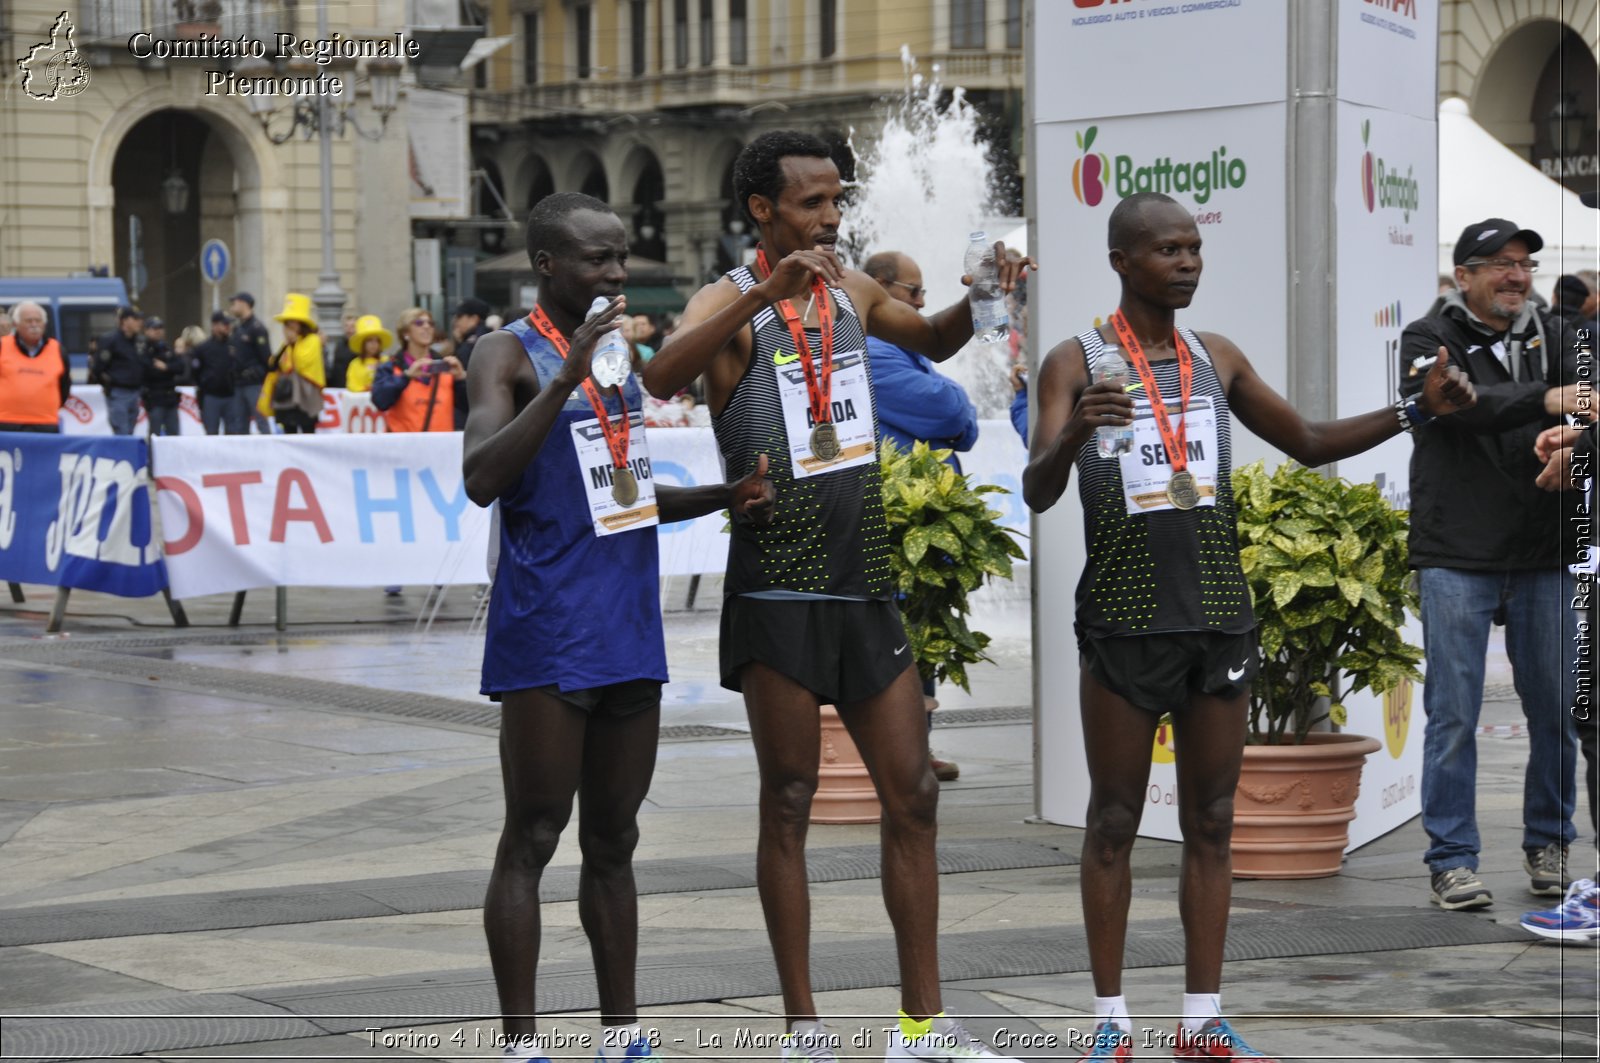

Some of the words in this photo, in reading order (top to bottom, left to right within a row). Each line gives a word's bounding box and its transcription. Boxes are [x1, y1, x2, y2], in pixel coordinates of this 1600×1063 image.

[1072, 14, 1112, 26] NOLEGGIO
[1114, 11, 1137, 21] AUTO
[1139, 9, 1145, 18] E
[1147, 6, 1179, 17] VEICOLI
[1181, 0, 1241, 13] COMMERCIALI
[1115, 145, 1247, 204] Battaglio
[1541, 155, 1598, 177] BANCA
[1378, 158, 1418, 224] Battaglio
